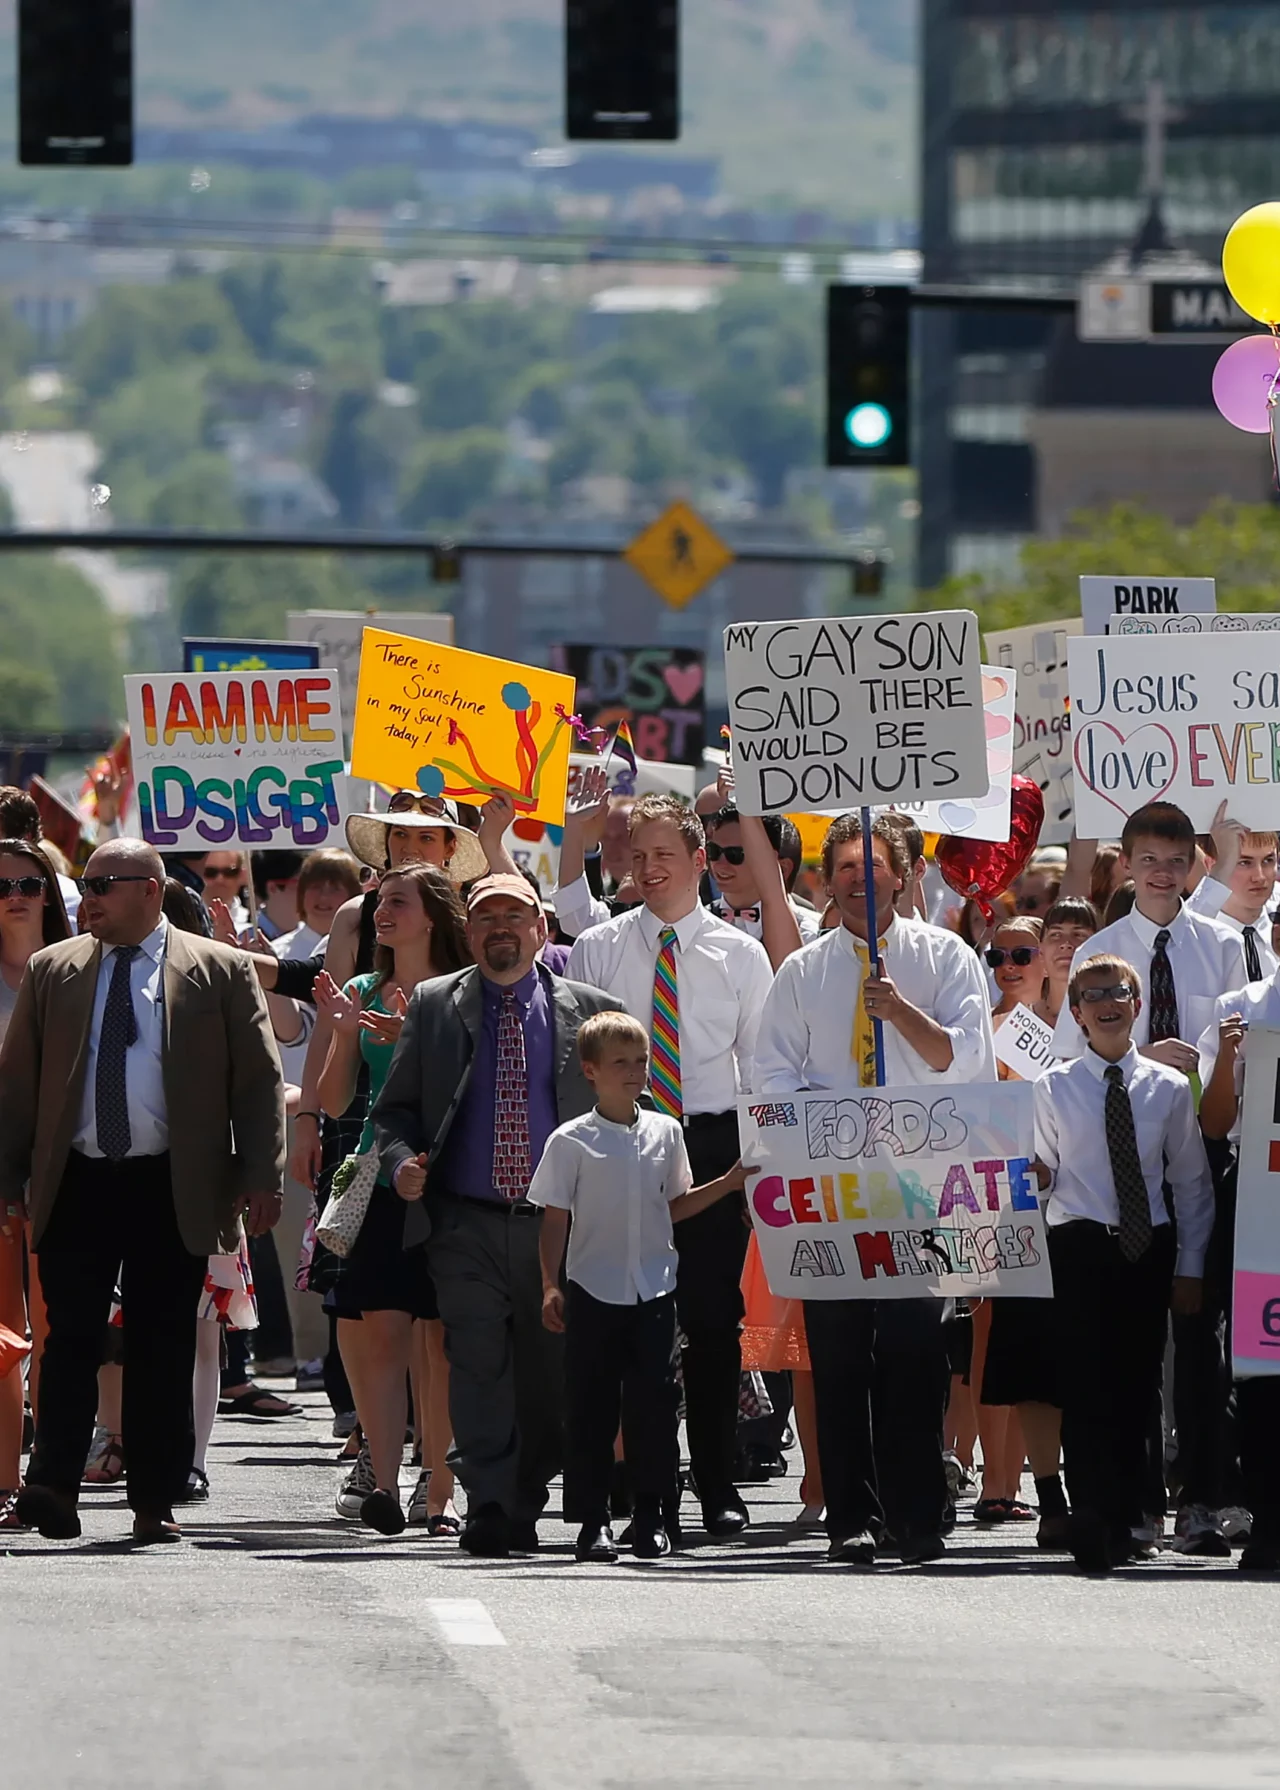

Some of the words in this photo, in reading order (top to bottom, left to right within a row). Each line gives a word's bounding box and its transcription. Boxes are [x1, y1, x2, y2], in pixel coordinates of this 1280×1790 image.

[1114, 585, 1179, 614] PARK
[375, 644, 418, 670] There
[427, 660, 441, 674] is
[727, 626, 759, 652] MY
[766, 624, 863, 680] GAY
[874, 620, 968, 671] SON
[367, 694, 380, 708] in
[389, 703, 411, 722] my
[403, 675, 486, 716] Sunshine
[735, 686, 840, 733] SAID
[860, 677, 972, 714] THERE
[1076, 648, 1198, 716] Jesus
[141, 682, 158, 746] I
[163, 680, 247, 746] AM
[251, 678, 336, 743] ME
[738, 731, 848, 762] WOULD
[876, 722, 927, 749] BE
[1087, 728, 1169, 791] love
[759, 751, 960, 811] DONUTS
[1014, 1010, 1052, 1047] MORMO
[748, 1102, 799, 1127] THE
[805, 1097, 968, 1160] FORDS
